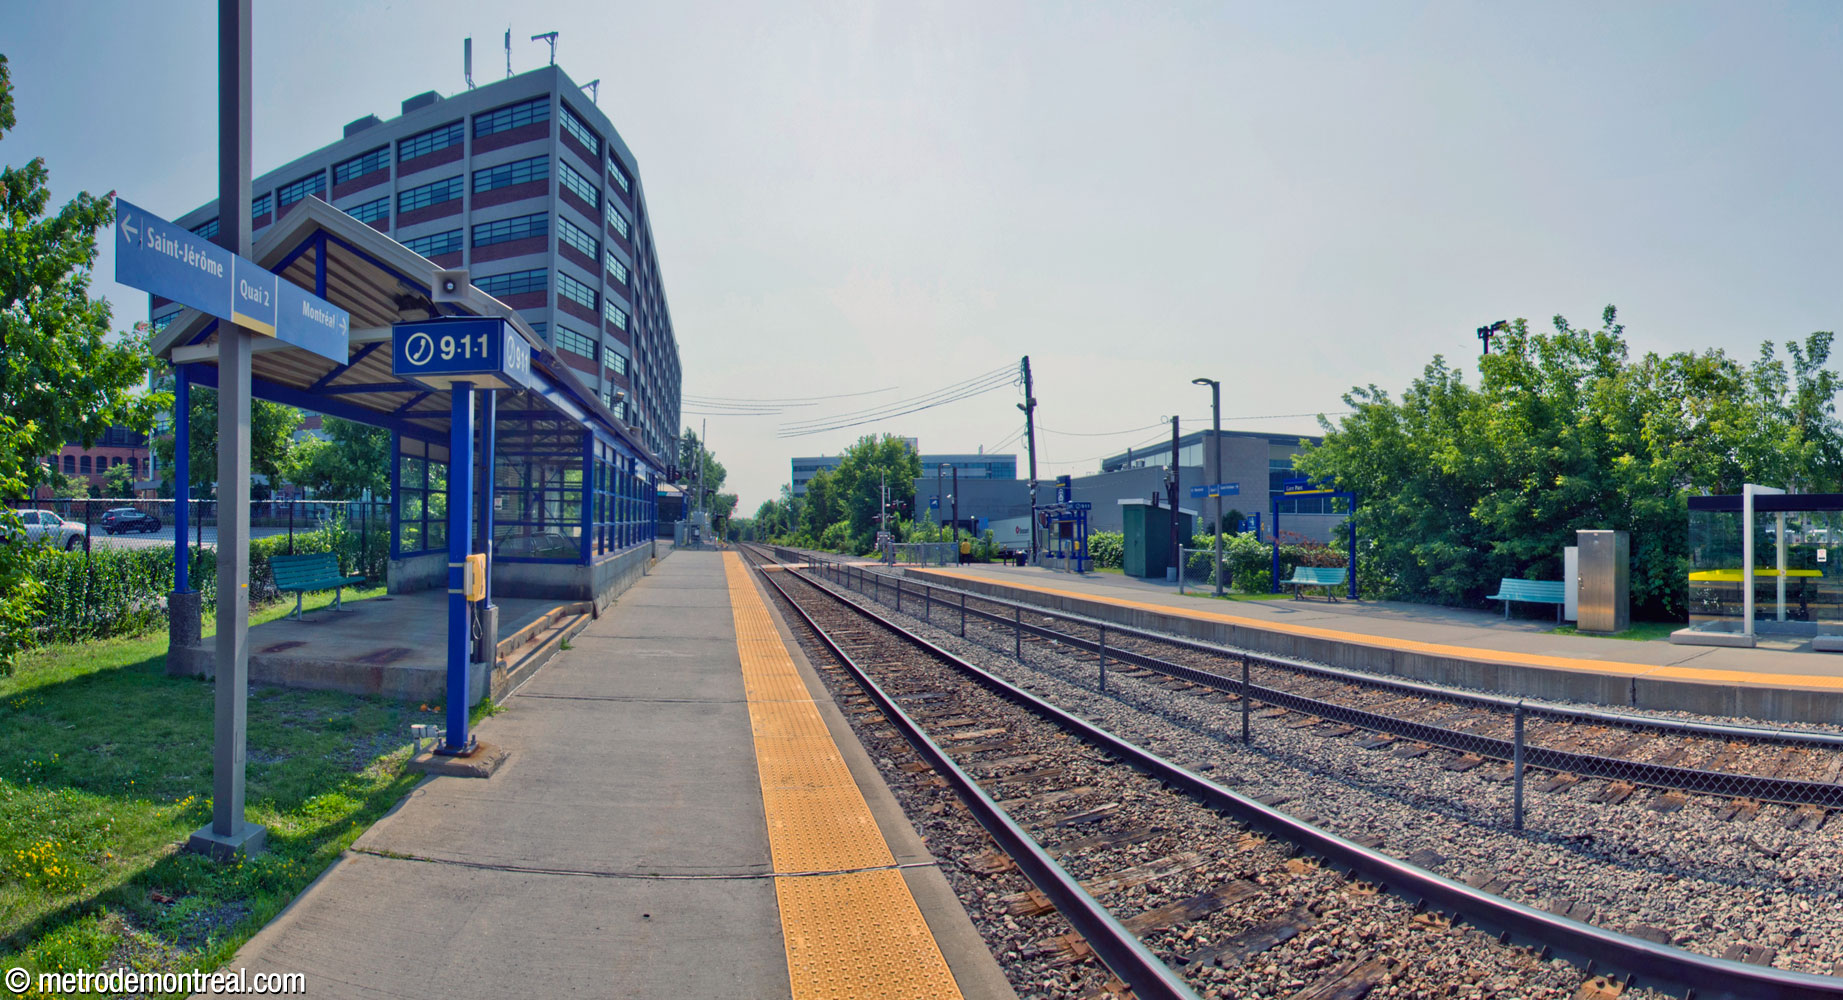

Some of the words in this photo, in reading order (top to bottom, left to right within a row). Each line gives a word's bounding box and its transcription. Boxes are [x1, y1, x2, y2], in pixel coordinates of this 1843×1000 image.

[147, 228, 224, 278] Saint-Jérôme
[240, 279, 263, 303] Quai
[264, 291, 270, 307] 2
[302, 300, 336, 329] Montréal
